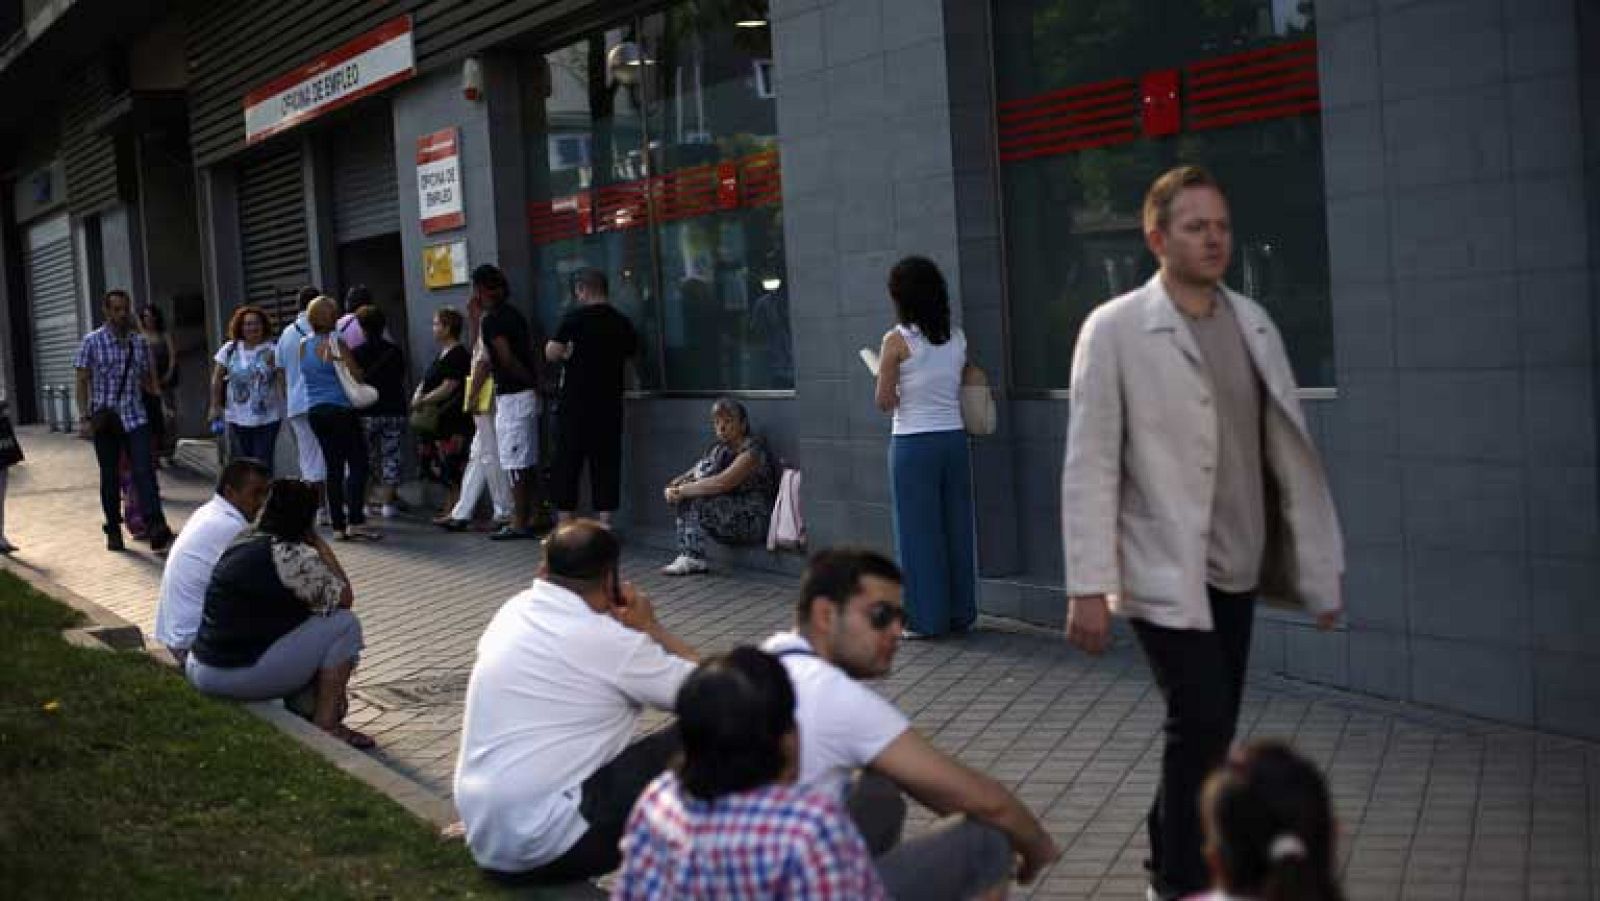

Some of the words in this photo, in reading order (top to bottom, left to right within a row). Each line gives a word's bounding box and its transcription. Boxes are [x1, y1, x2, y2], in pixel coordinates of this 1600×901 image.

[281, 83, 311, 115] OFICINA
[312, 78, 324, 102] DE
[325, 62, 360, 97] EMPLEO
[420, 168, 444, 191] OFICINA
[445, 166, 455, 184] DE
[427, 187, 453, 208] EMPLEO
